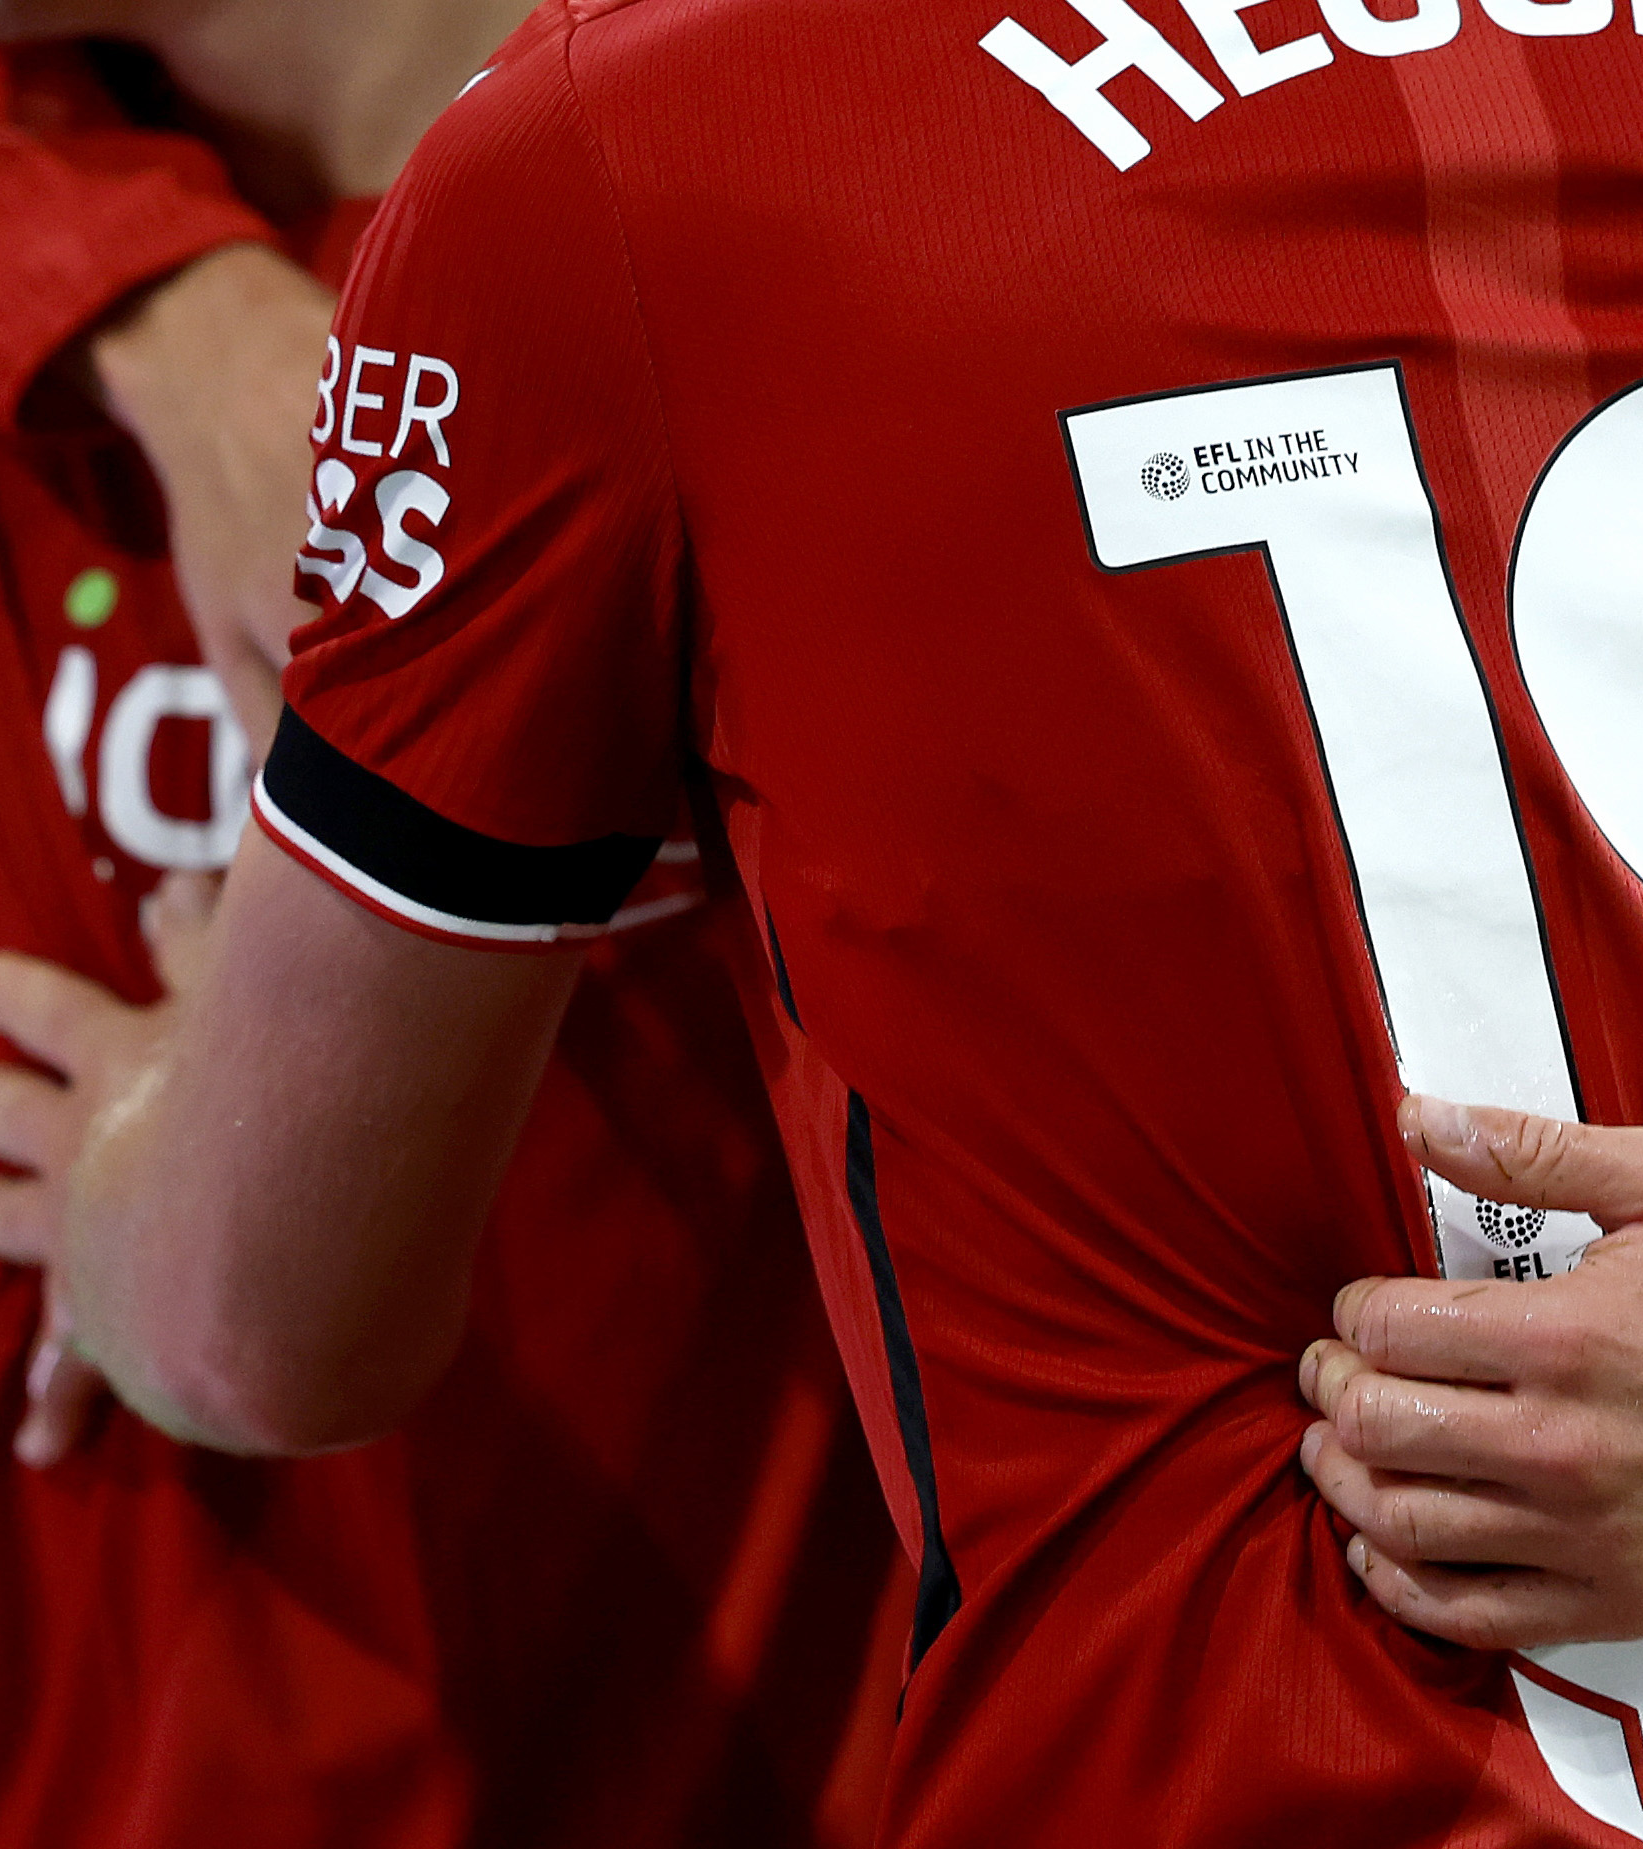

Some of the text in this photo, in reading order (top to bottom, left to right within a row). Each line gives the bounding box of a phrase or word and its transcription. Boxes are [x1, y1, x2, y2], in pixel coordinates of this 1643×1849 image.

[1193, 429, 1328, 468] EFL IN THE
[1201, 452, 1358, 494] COMMUNITY
[1493, 1251, 1552, 1283] EFL
